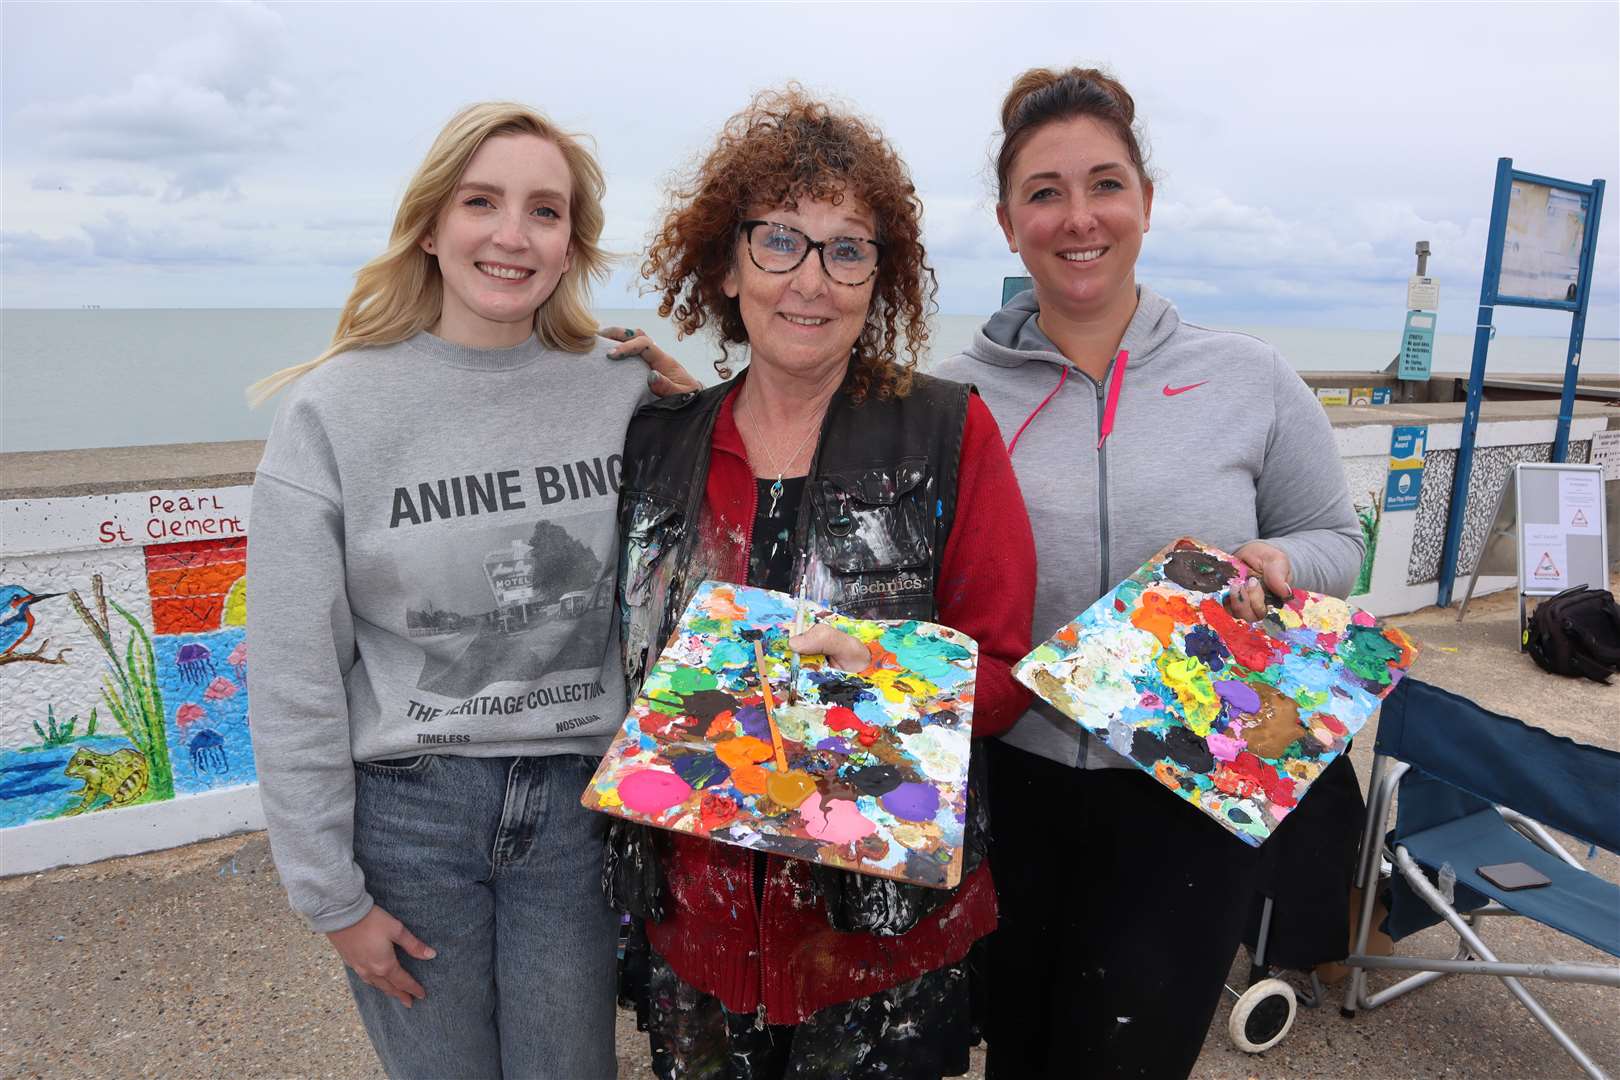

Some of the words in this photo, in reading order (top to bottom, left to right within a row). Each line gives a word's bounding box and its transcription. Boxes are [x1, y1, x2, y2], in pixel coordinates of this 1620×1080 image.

[389, 469, 526, 528] ANINE
[99, 520, 133, 543] St
[147, 516, 246, 538] Clement
[496, 576, 531, 587] MOTEL
[406, 699, 442, 723] THE
[416, 733, 471, 744] TIMELESS
